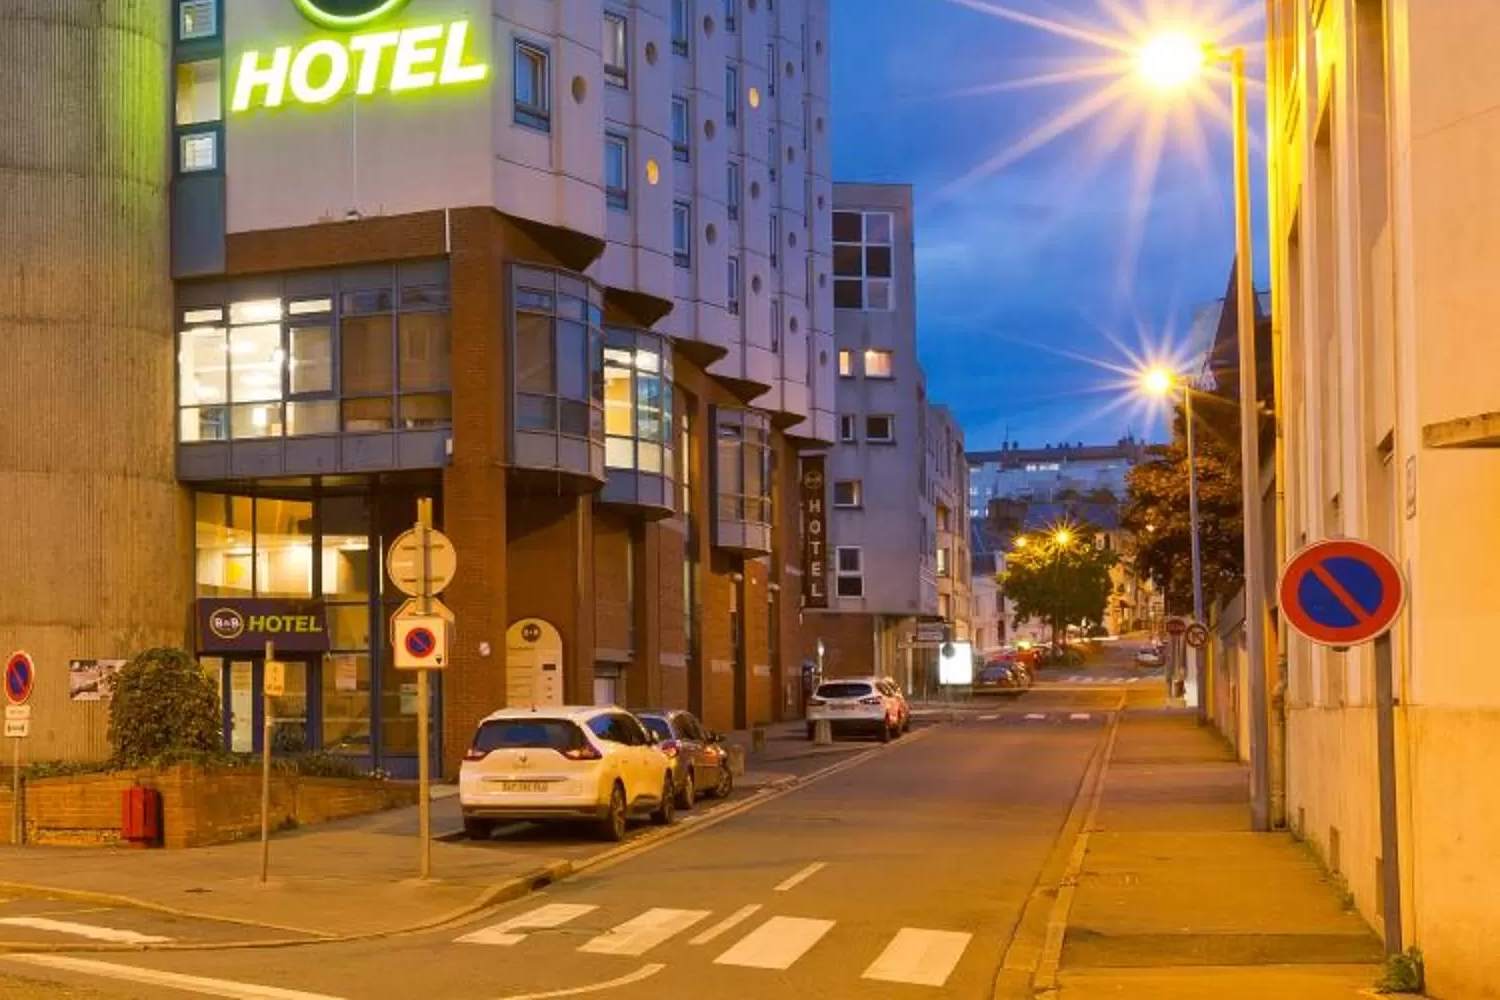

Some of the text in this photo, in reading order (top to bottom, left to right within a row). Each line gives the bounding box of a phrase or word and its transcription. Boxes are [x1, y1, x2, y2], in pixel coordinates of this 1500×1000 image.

[230, 19, 488, 112] HOTEL
[808, 499, 823, 598] HOTEL
[248, 615, 323, 633] HOTEL
